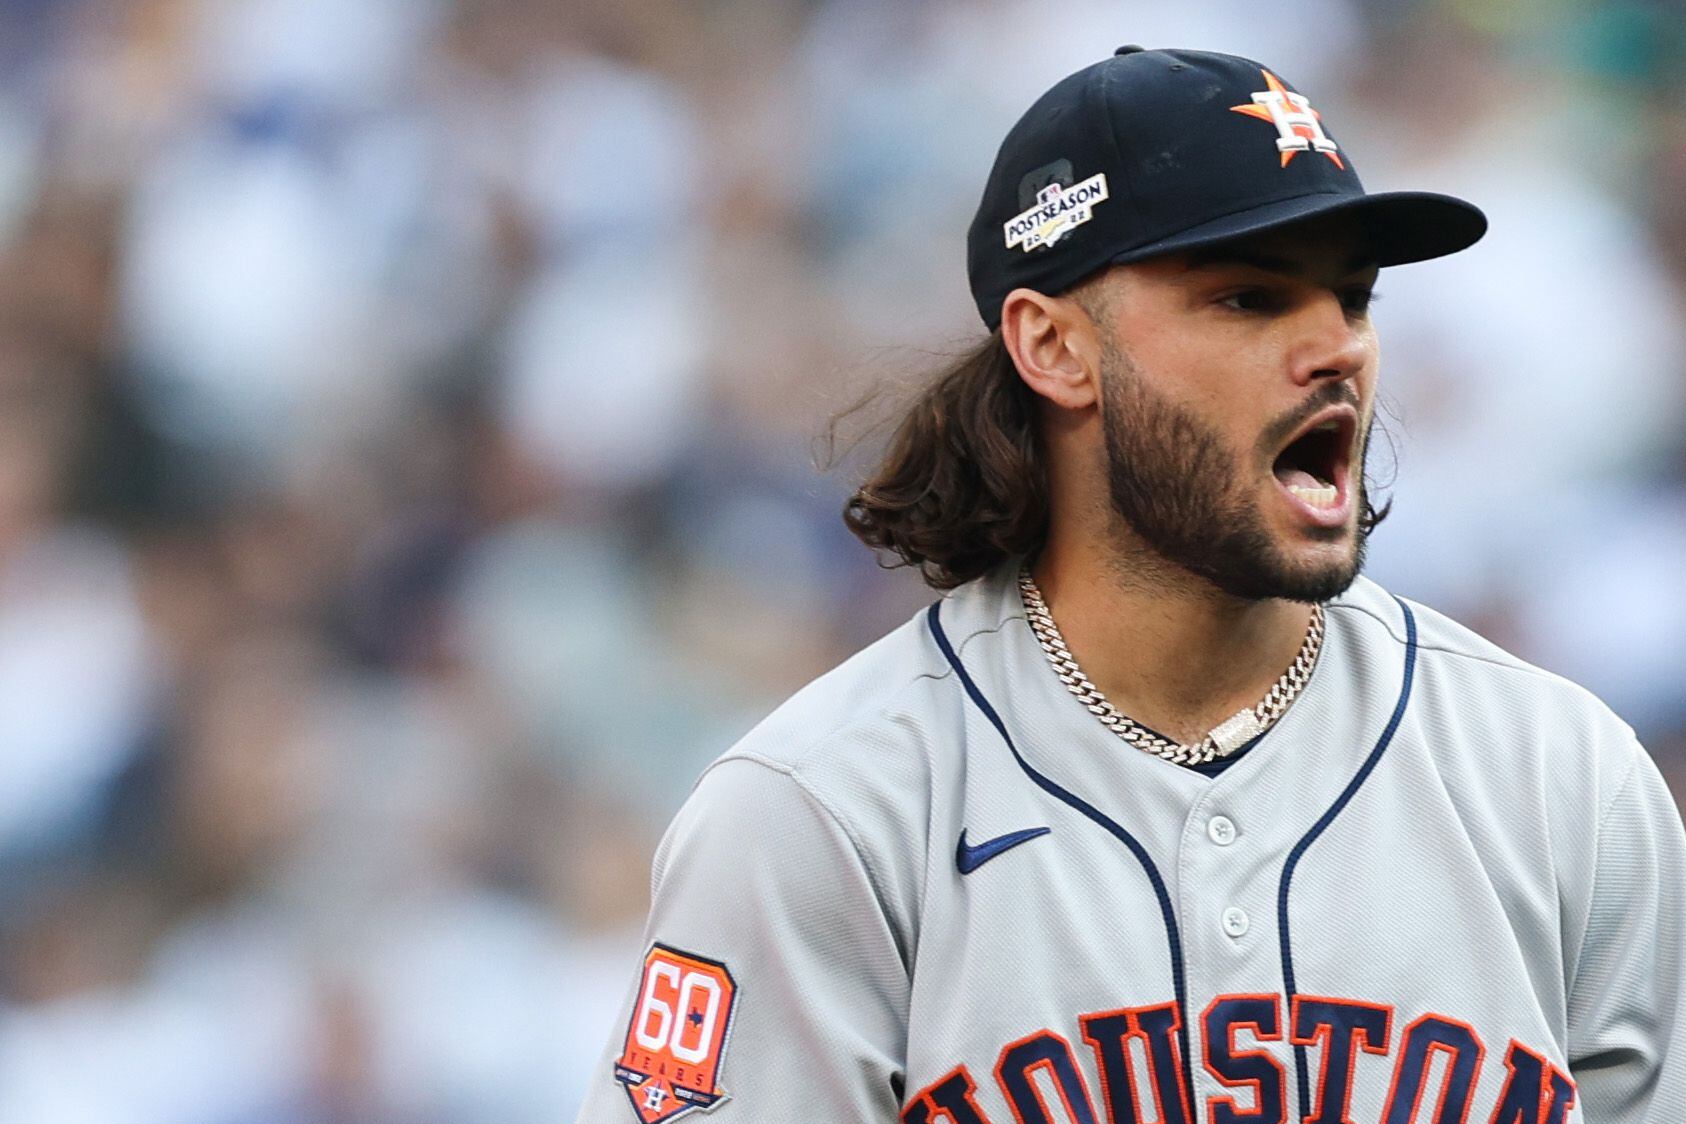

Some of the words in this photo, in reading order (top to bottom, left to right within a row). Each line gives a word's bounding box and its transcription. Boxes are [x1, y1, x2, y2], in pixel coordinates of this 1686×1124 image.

[1251, 91, 1337, 153] H
[1008, 182, 1101, 241] POSTSEASON
[636, 960, 721, 1064] 60
